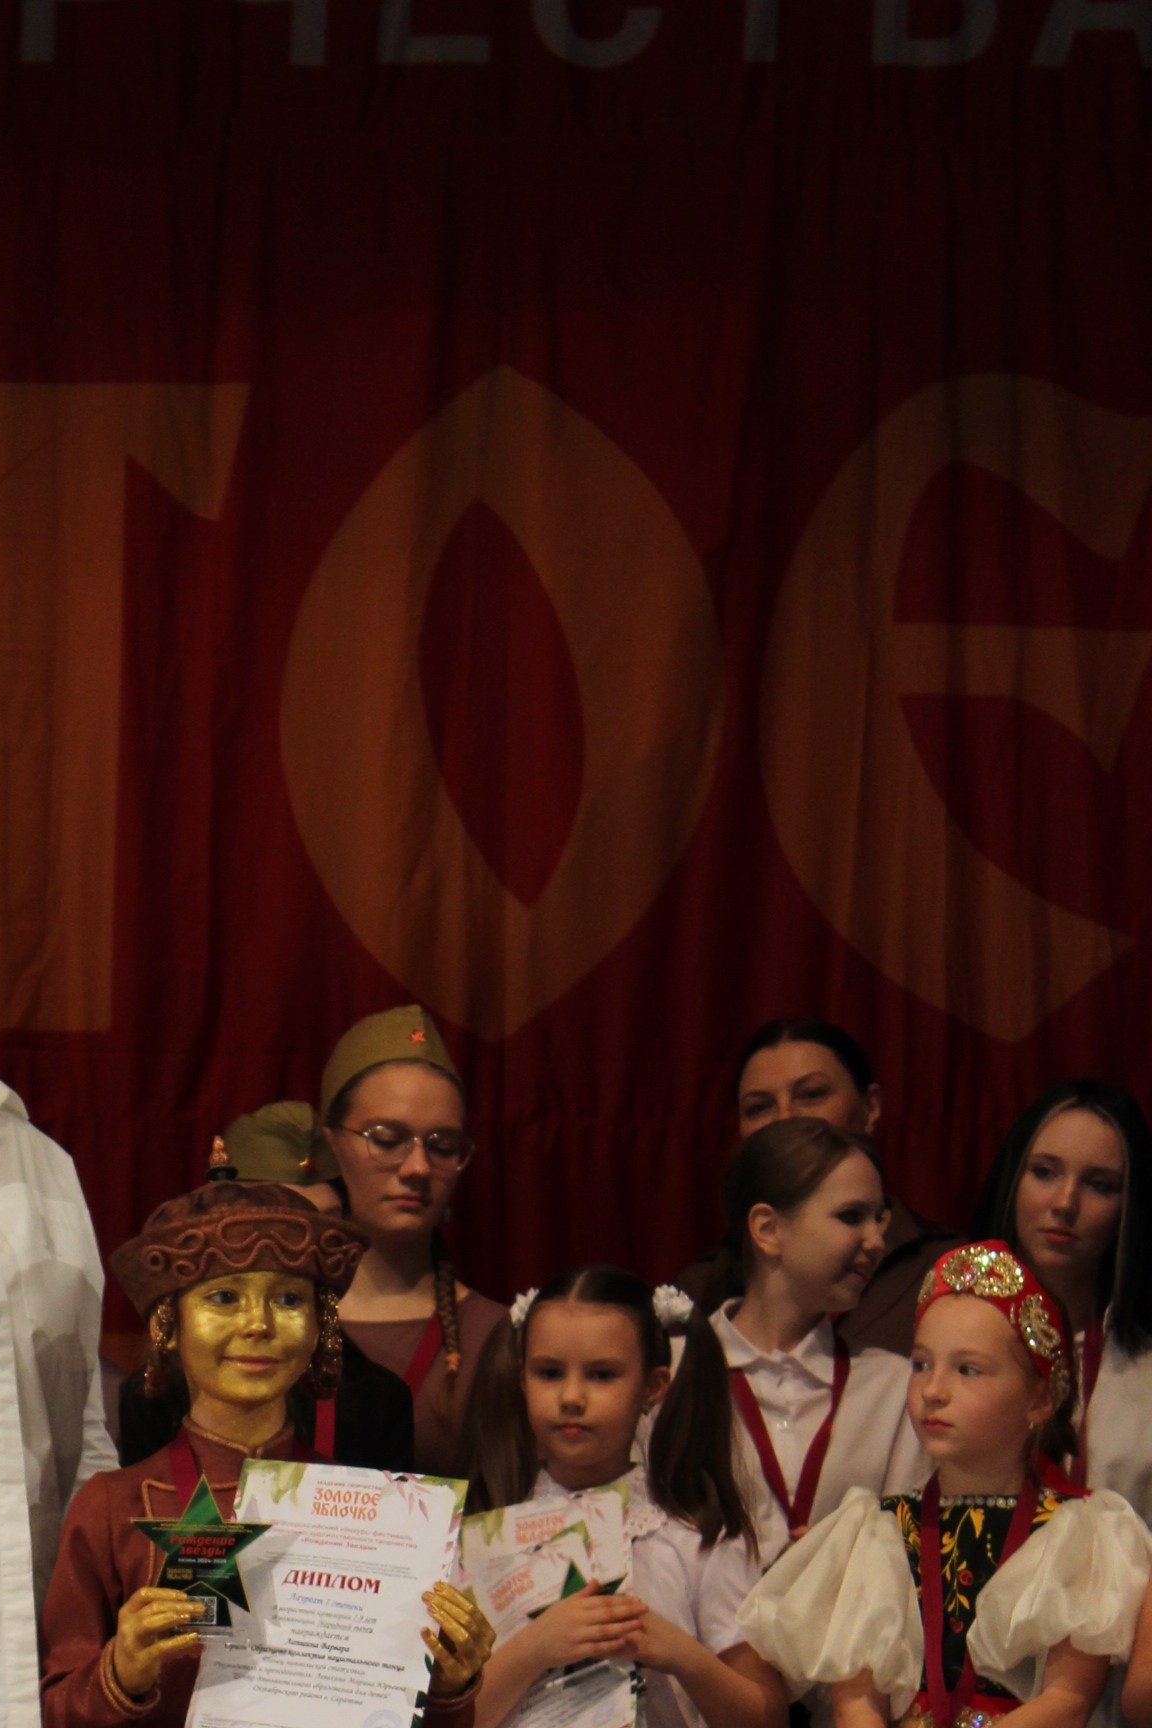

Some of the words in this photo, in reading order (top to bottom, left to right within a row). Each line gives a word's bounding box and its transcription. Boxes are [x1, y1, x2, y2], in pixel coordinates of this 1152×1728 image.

[314, 1487, 382, 1506] ЗОЛОТОЕ
[311, 1501, 377, 1521] ЯБЛОЧКО
[170, 1534, 236, 1547] Рождение
[282, 1569, 381, 1594] ДИПЛОМ
